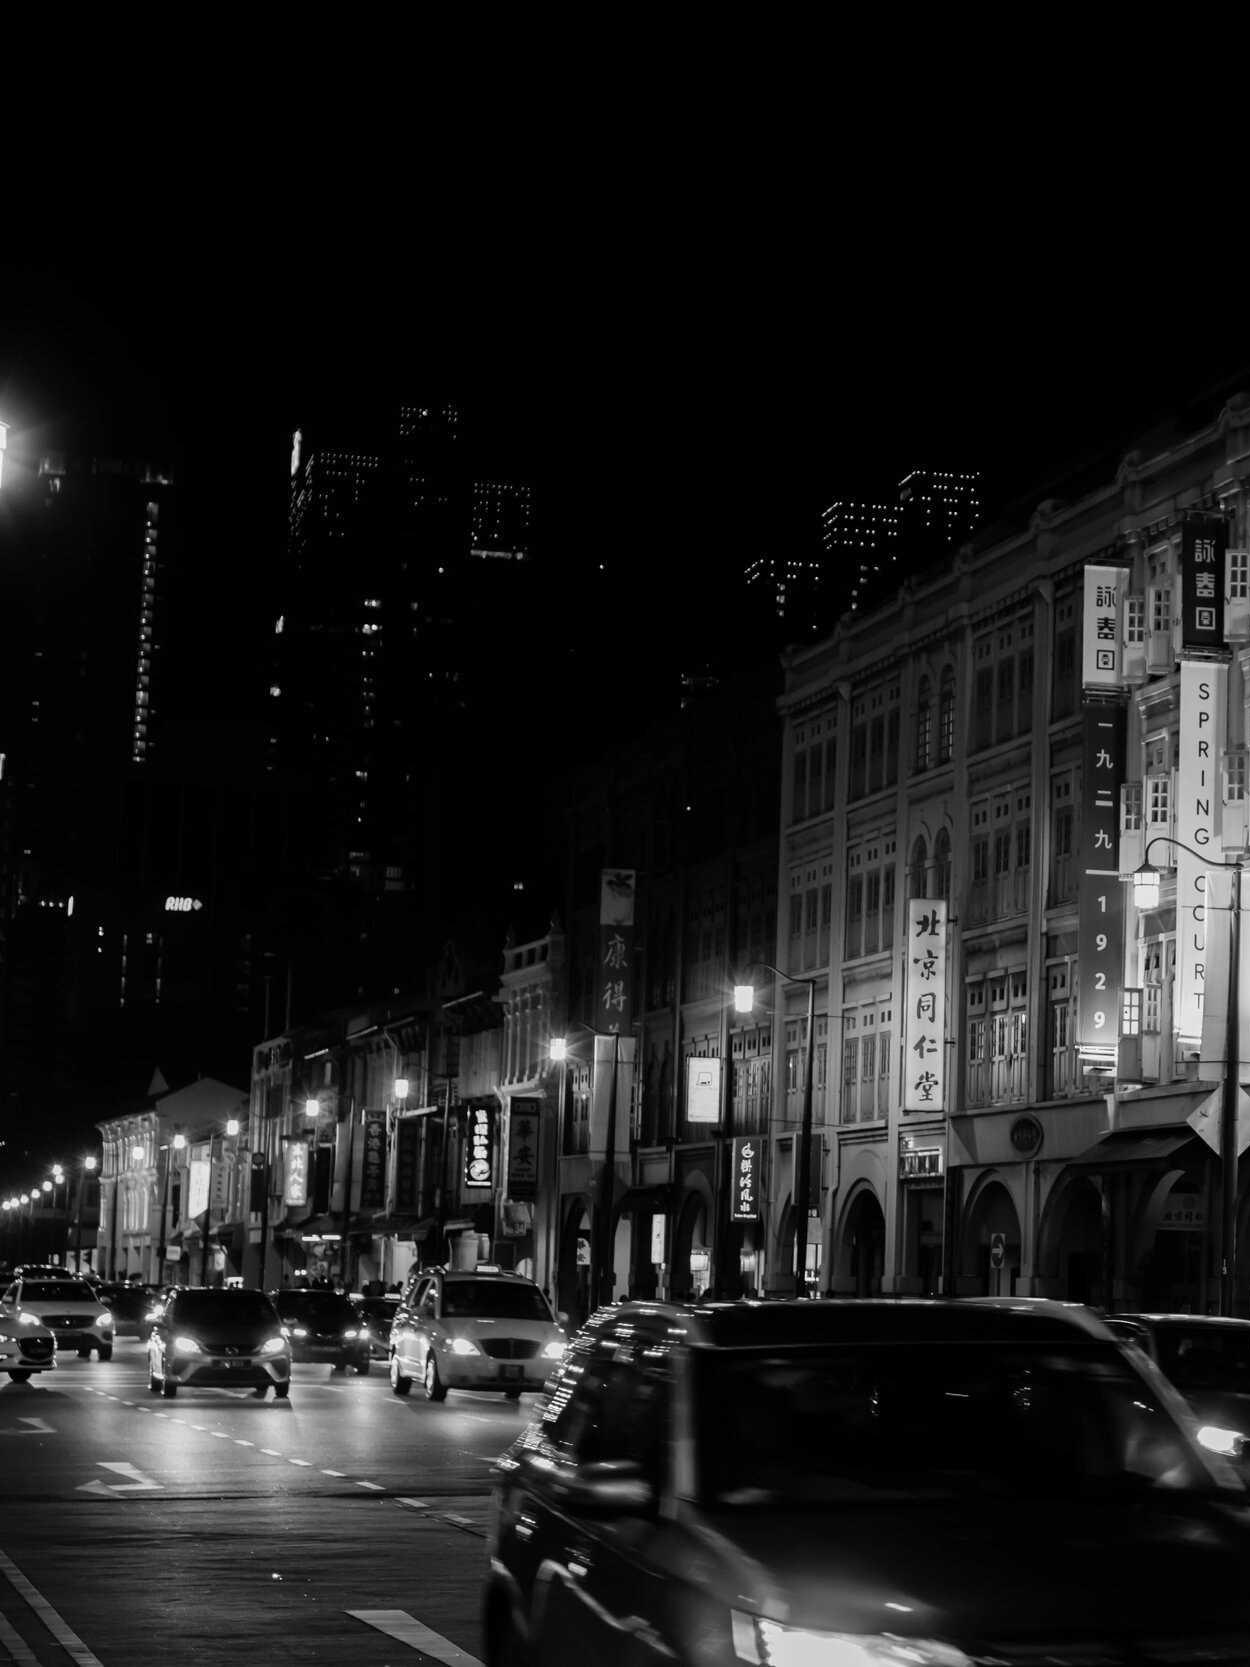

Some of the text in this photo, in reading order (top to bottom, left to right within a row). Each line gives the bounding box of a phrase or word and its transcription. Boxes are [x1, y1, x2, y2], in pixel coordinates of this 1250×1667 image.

[1193, 682, 1210, 846] SPRING
[1094, 722, 1114, 1029] 一九二九 1929
[913, 909, 940, 1102] 北京同仁堂
